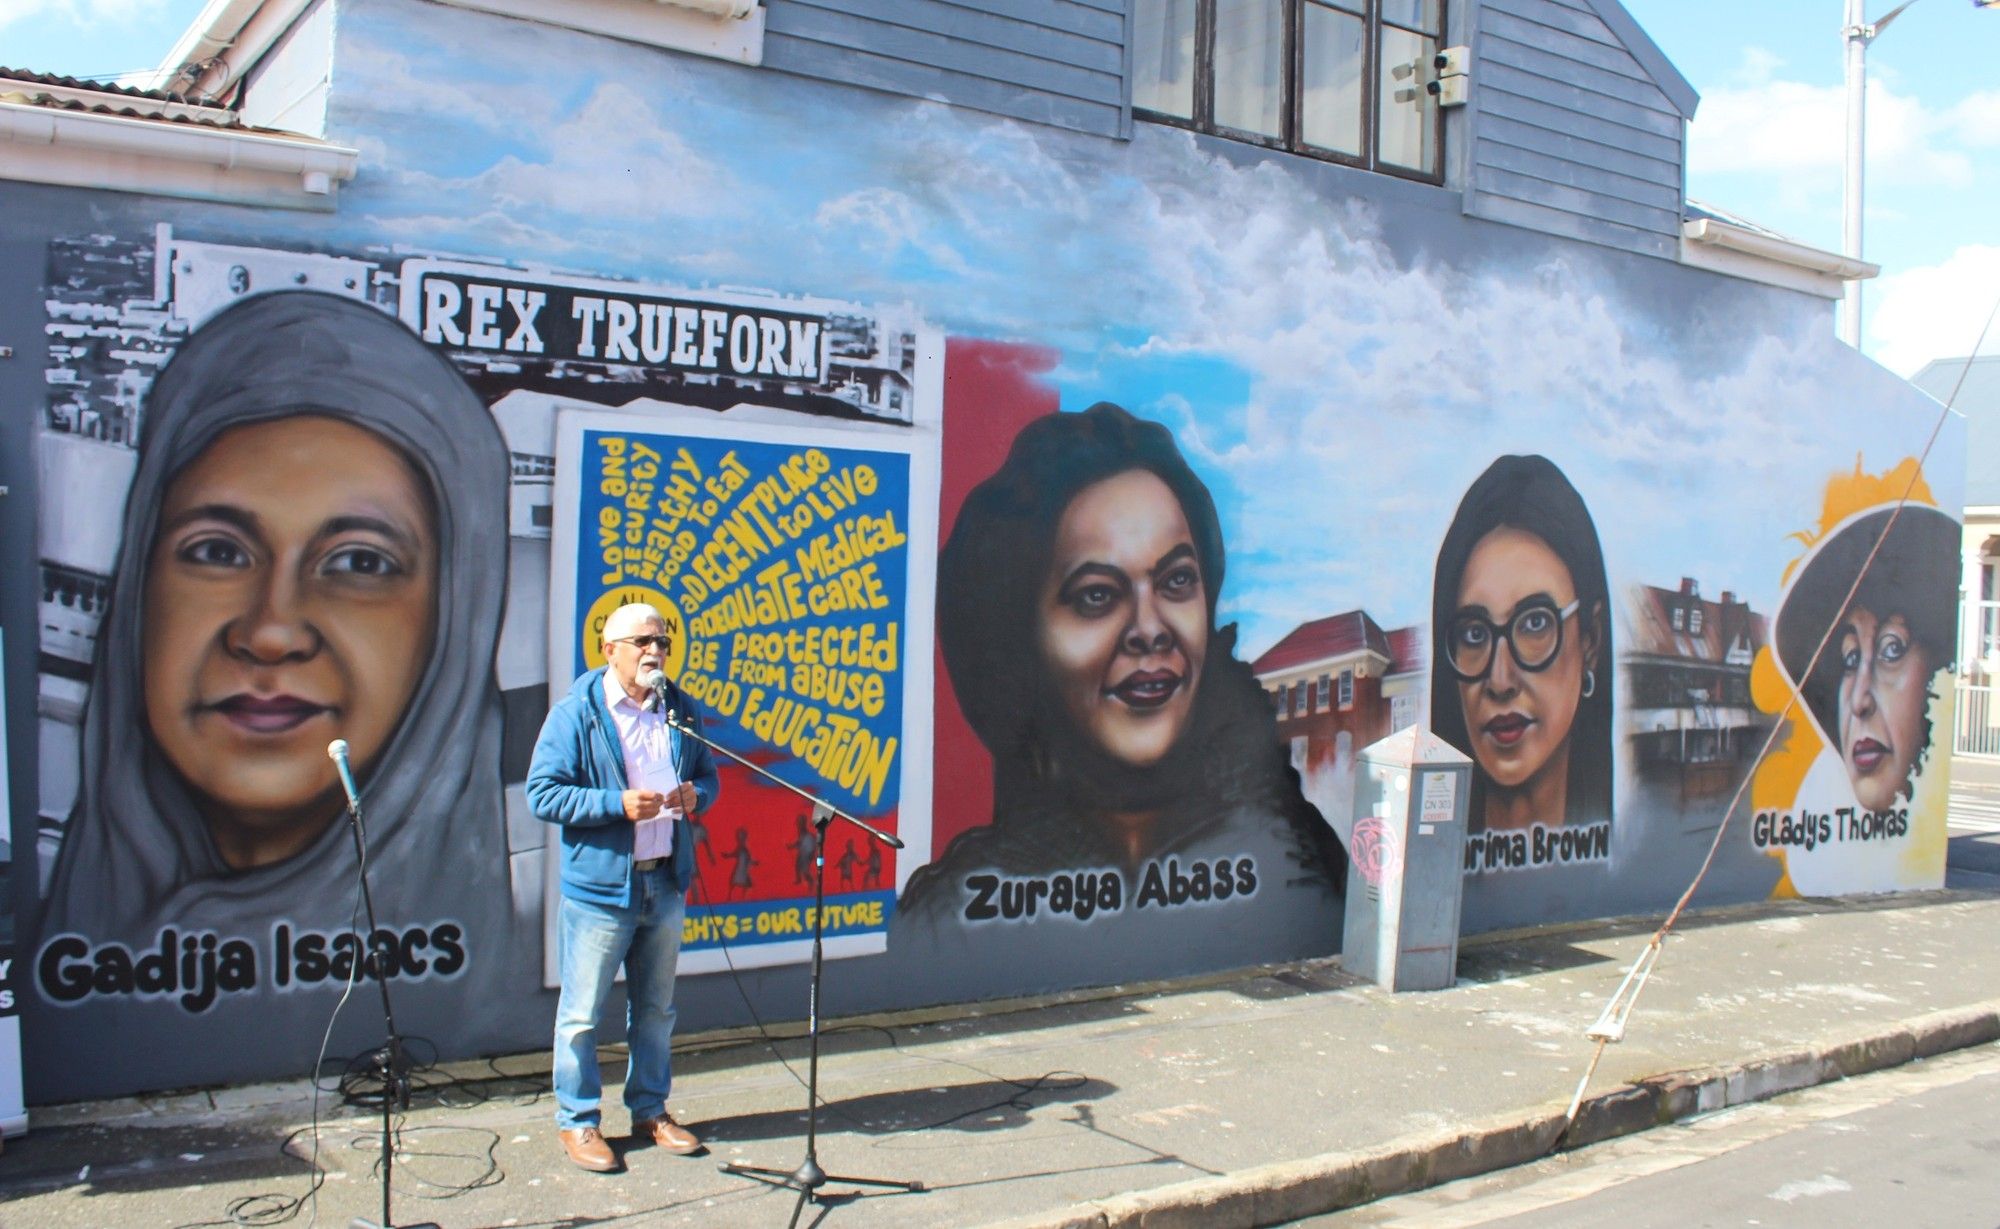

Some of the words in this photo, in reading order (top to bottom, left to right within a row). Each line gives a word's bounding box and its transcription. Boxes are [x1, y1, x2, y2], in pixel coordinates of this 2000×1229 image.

[423, 279, 546, 354] REX
[571, 296, 819, 378] TRUEFORM
[656, 529, 697, 590] FOOD
[687, 640, 720, 673] BE
[728, 658, 787, 691] FROM
[679, 671, 741, 717] GOOD
[1464, 830, 1527, 871] rima
[965, 872, 1122, 921] Zuraya
[1136, 859, 1257, 909] Abass
[680, 914, 739, 945] GHTS
[756, 908, 803, 936] OUR
[38, 929, 257, 1013] Gadija
[274, 923, 465, 988] Isaacs
